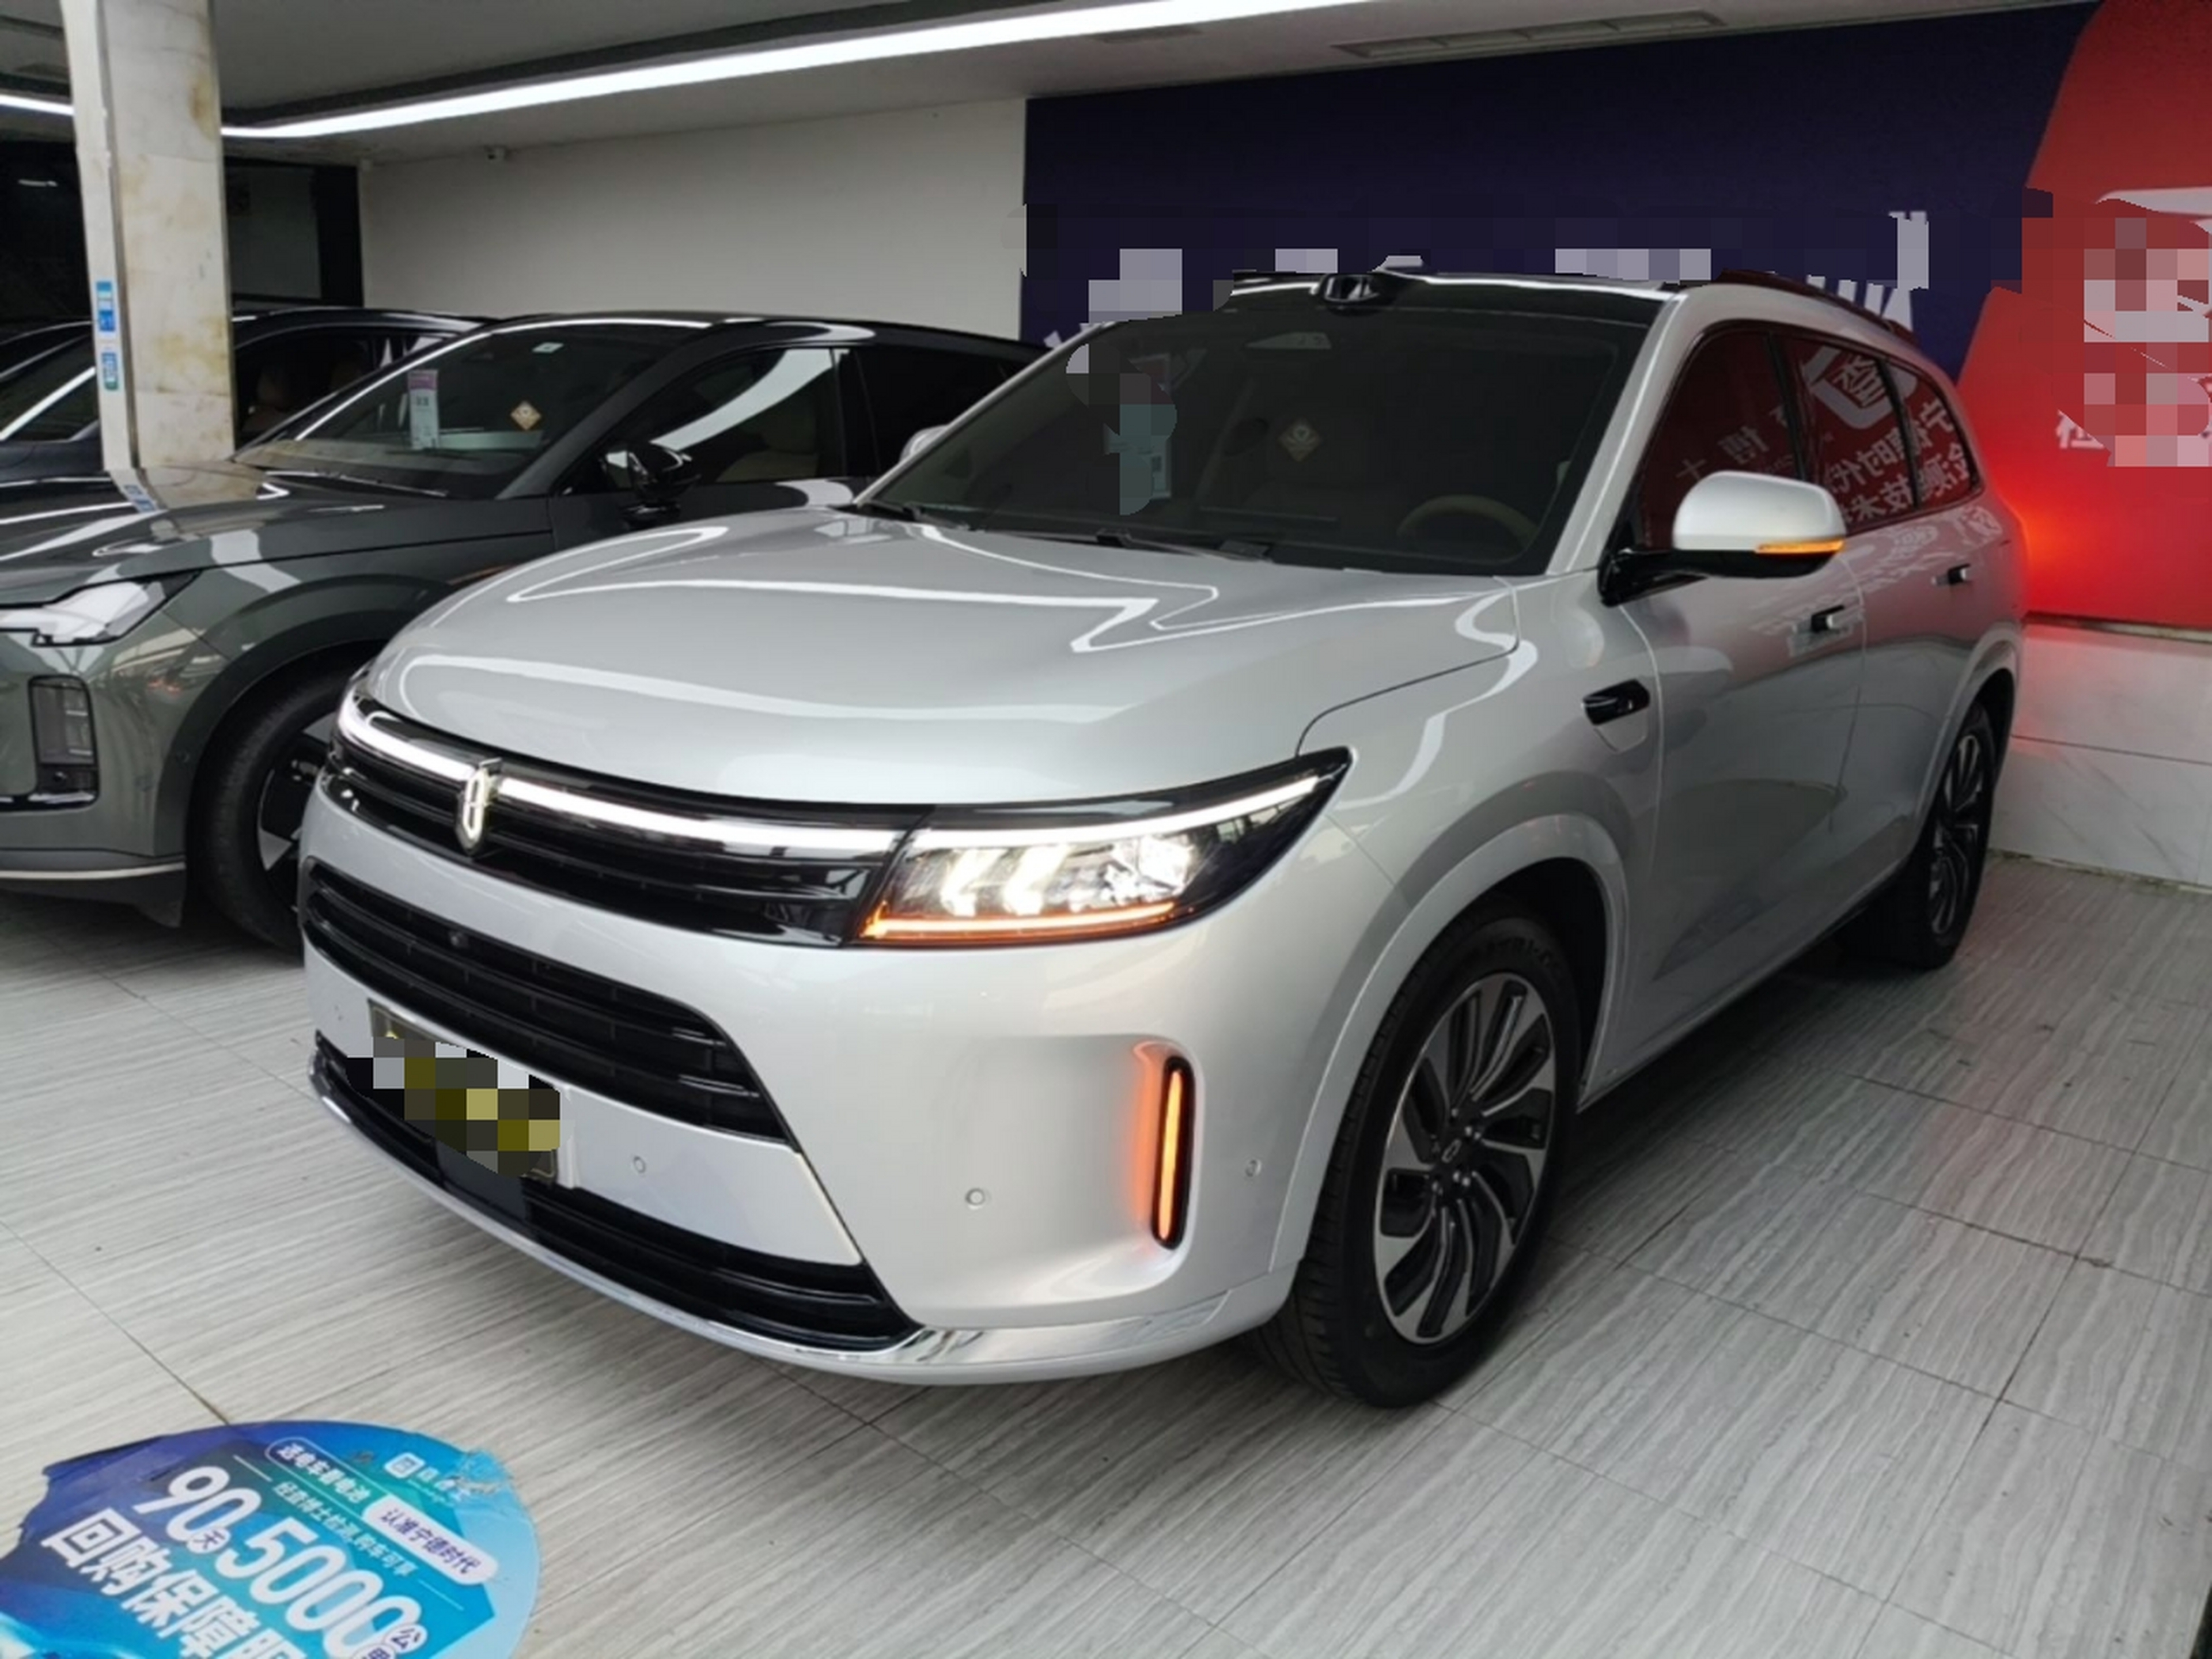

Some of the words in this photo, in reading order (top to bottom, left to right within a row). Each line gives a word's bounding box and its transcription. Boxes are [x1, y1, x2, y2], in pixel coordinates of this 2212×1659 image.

[380, 1508, 482, 1575] 认准宁德时代
